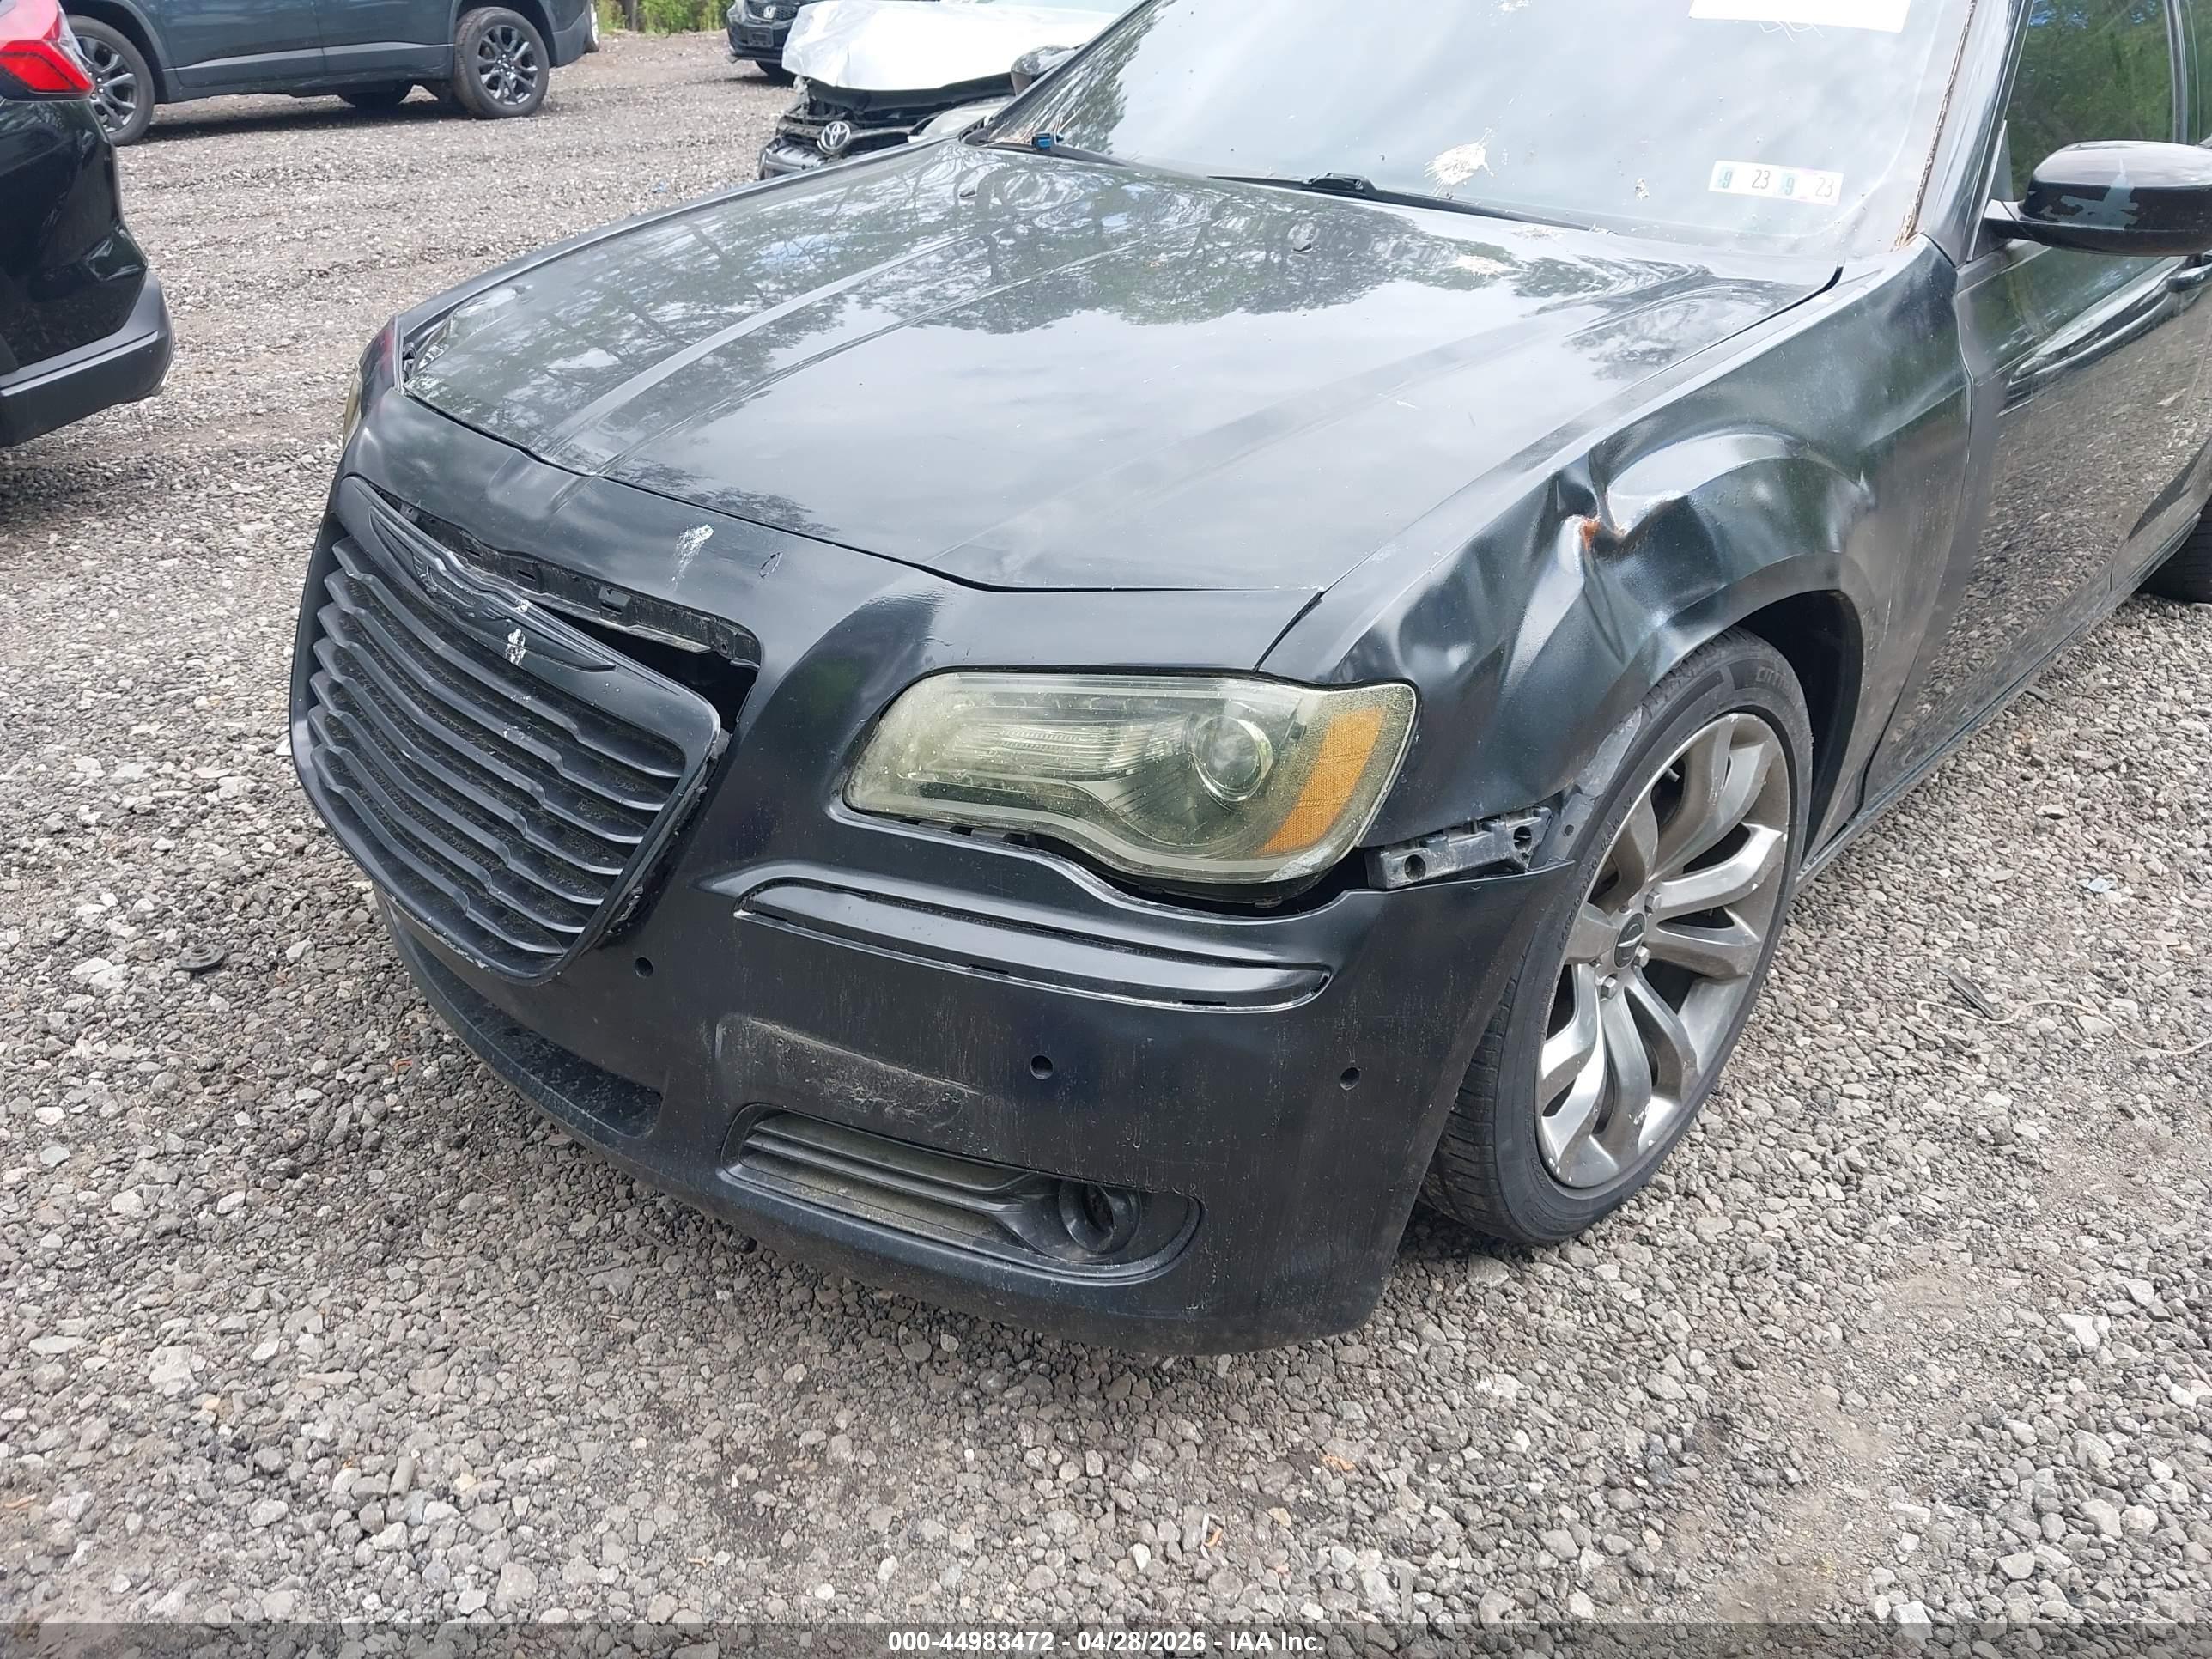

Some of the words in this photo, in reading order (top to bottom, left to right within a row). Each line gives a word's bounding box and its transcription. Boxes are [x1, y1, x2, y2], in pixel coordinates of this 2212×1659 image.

[1722, 171, 1733, 189] 9
[1751, 169, 1771, 190] 23
[1784, 177, 1796, 197] 9
[1815, 177, 1835, 198] 23
